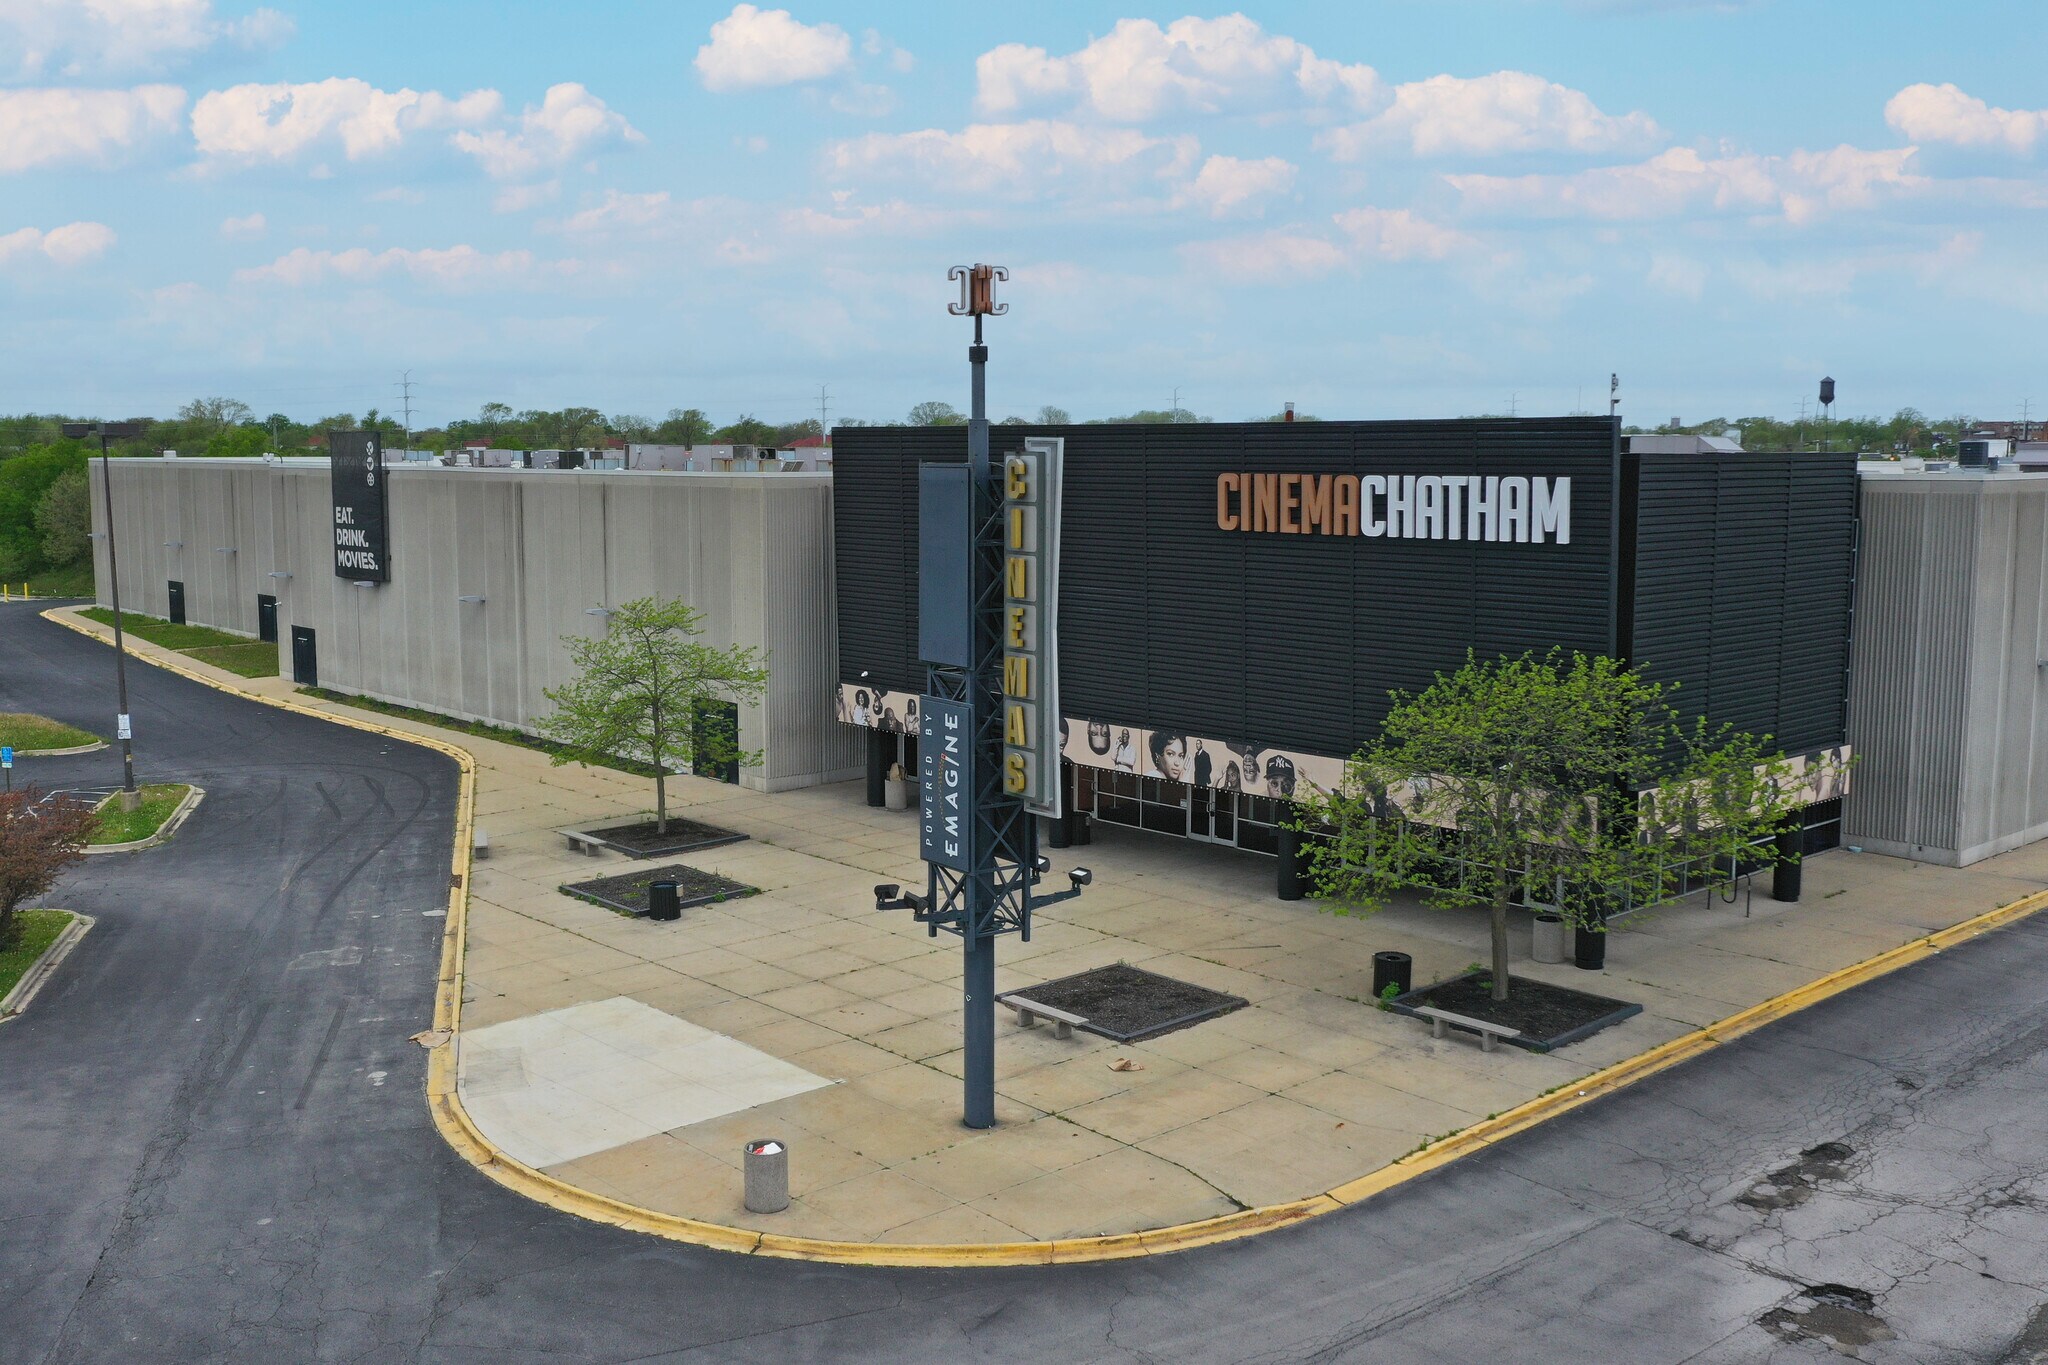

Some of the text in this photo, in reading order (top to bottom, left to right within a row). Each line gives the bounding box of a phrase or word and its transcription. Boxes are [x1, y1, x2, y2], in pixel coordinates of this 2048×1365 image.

[335, 506, 354, 525] EAT.
[336, 528, 369, 548] DRINK.
[337, 550, 379, 570] MOVIES.
[1003, 458, 1028, 793] CINEMAS
[925, 713, 933, 846] POWERED BY
[943, 712, 960, 858] EMAGINE
